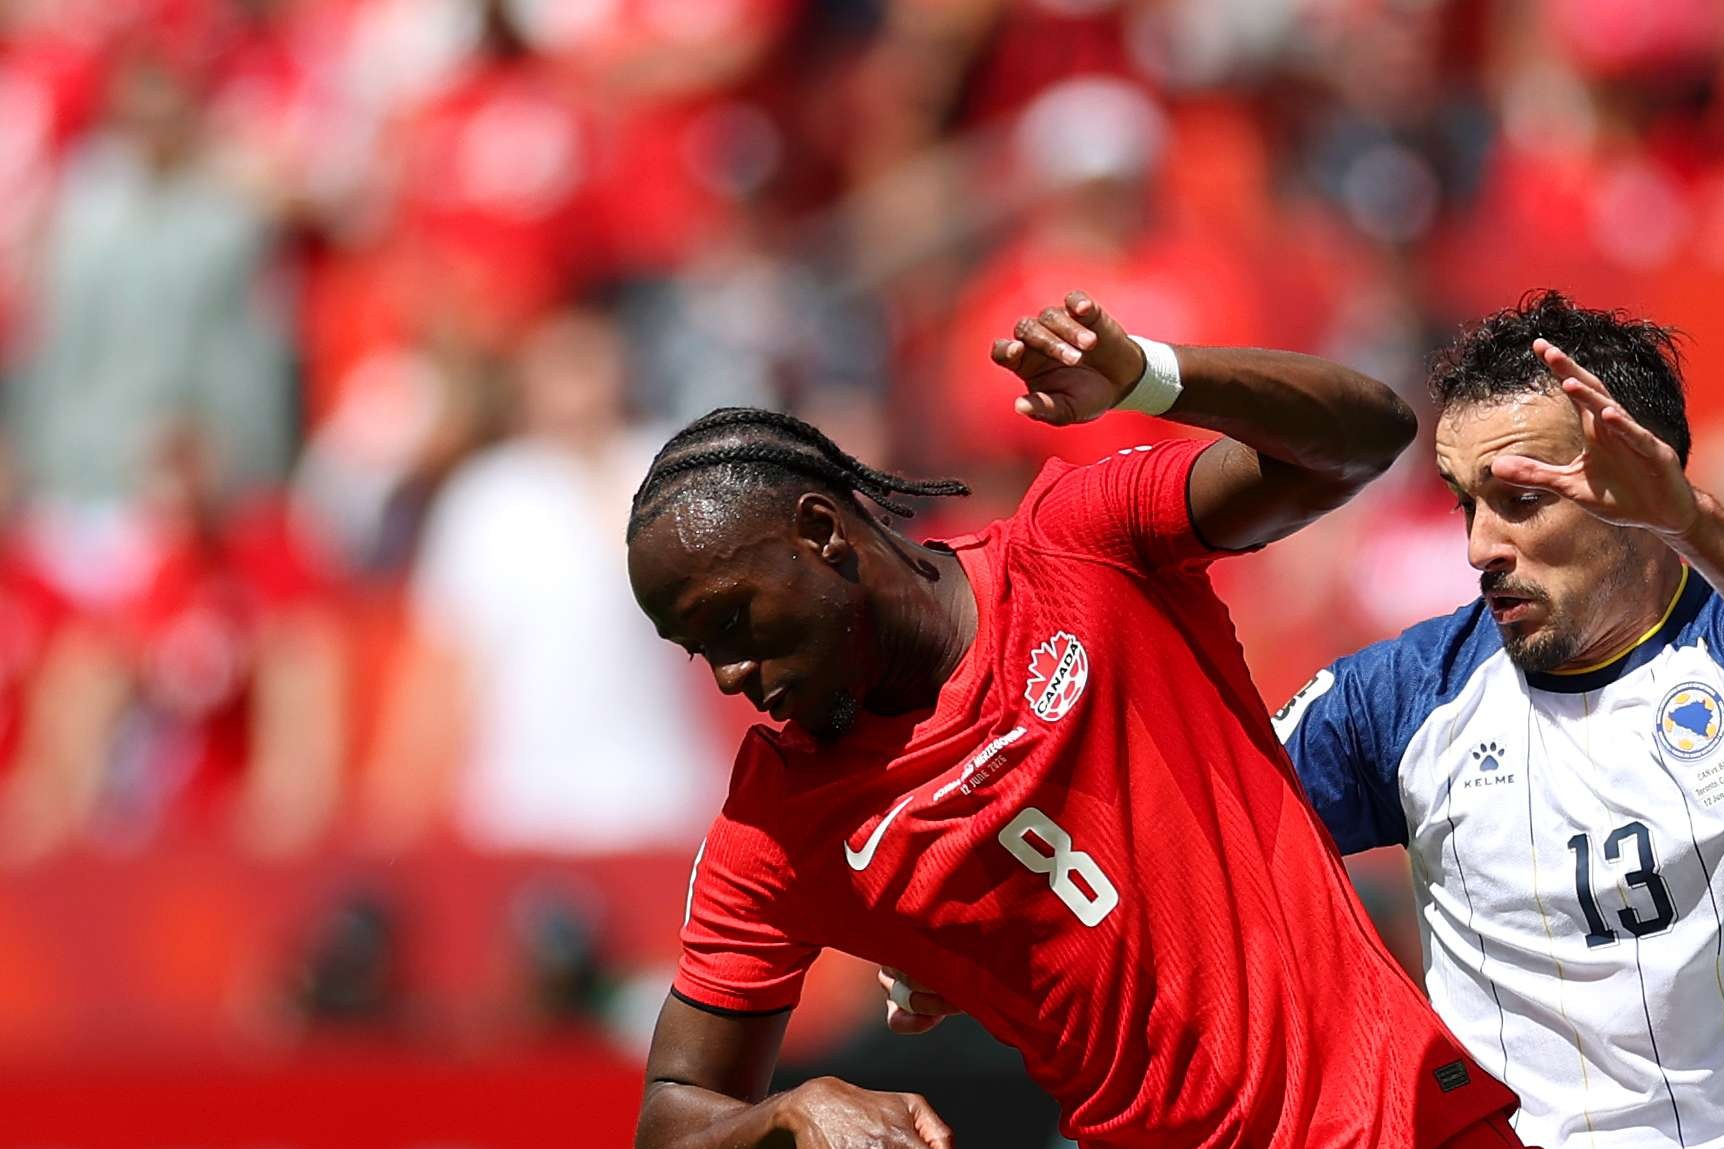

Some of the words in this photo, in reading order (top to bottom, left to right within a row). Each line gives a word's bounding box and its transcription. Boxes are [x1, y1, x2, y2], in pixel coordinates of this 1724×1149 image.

[1037, 642, 1078, 714] CANADA
[969, 769, 990, 788] JUNE
[1464, 774, 1515, 789] KELME
[998, 806, 1120, 927] 8
[1567, 821, 1679, 950] 13
